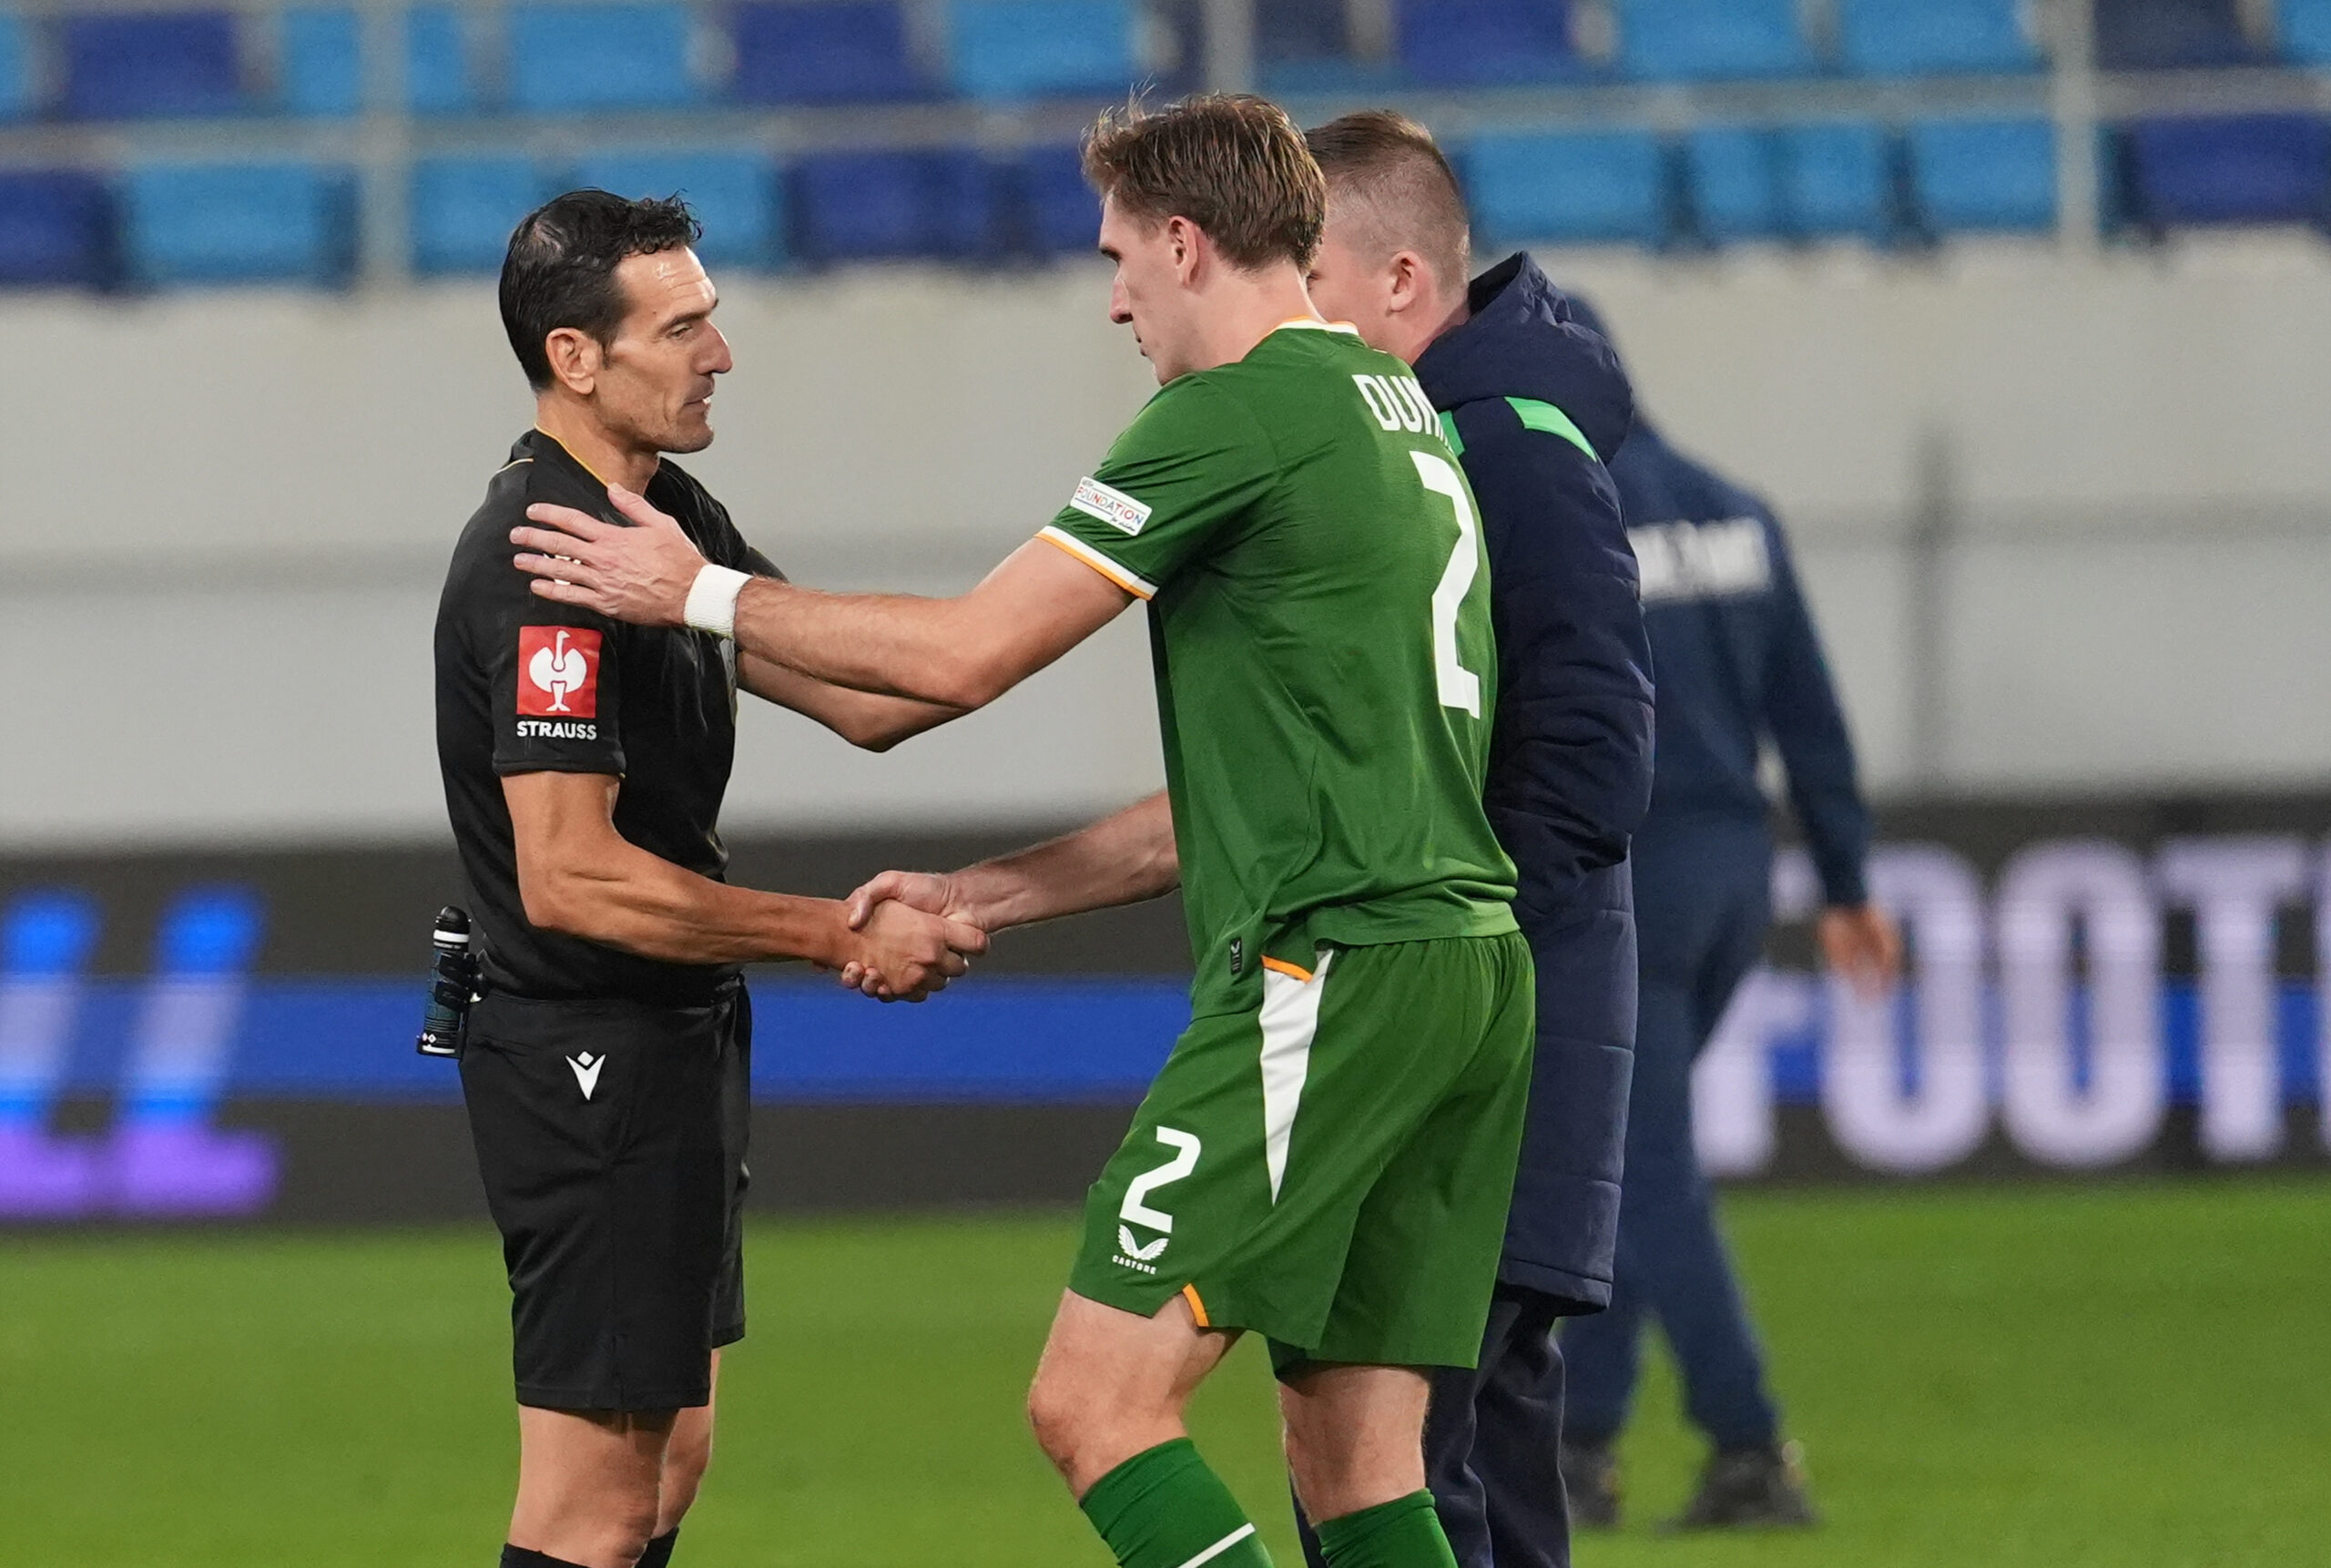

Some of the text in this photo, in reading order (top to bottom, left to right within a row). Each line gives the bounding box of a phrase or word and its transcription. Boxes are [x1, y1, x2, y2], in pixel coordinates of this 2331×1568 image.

[1351, 374, 1454, 453] DUN
[1075, 485, 1145, 525] FOUNDATION
[1410, 451, 1481, 719] 2
[516, 720, 597, 740] STRAUSS
[1691, 836, 2331, 1173] FOOT
[1119, 1125, 1202, 1234] 2
[1112, 1254, 1157, 1275] CASTORE
